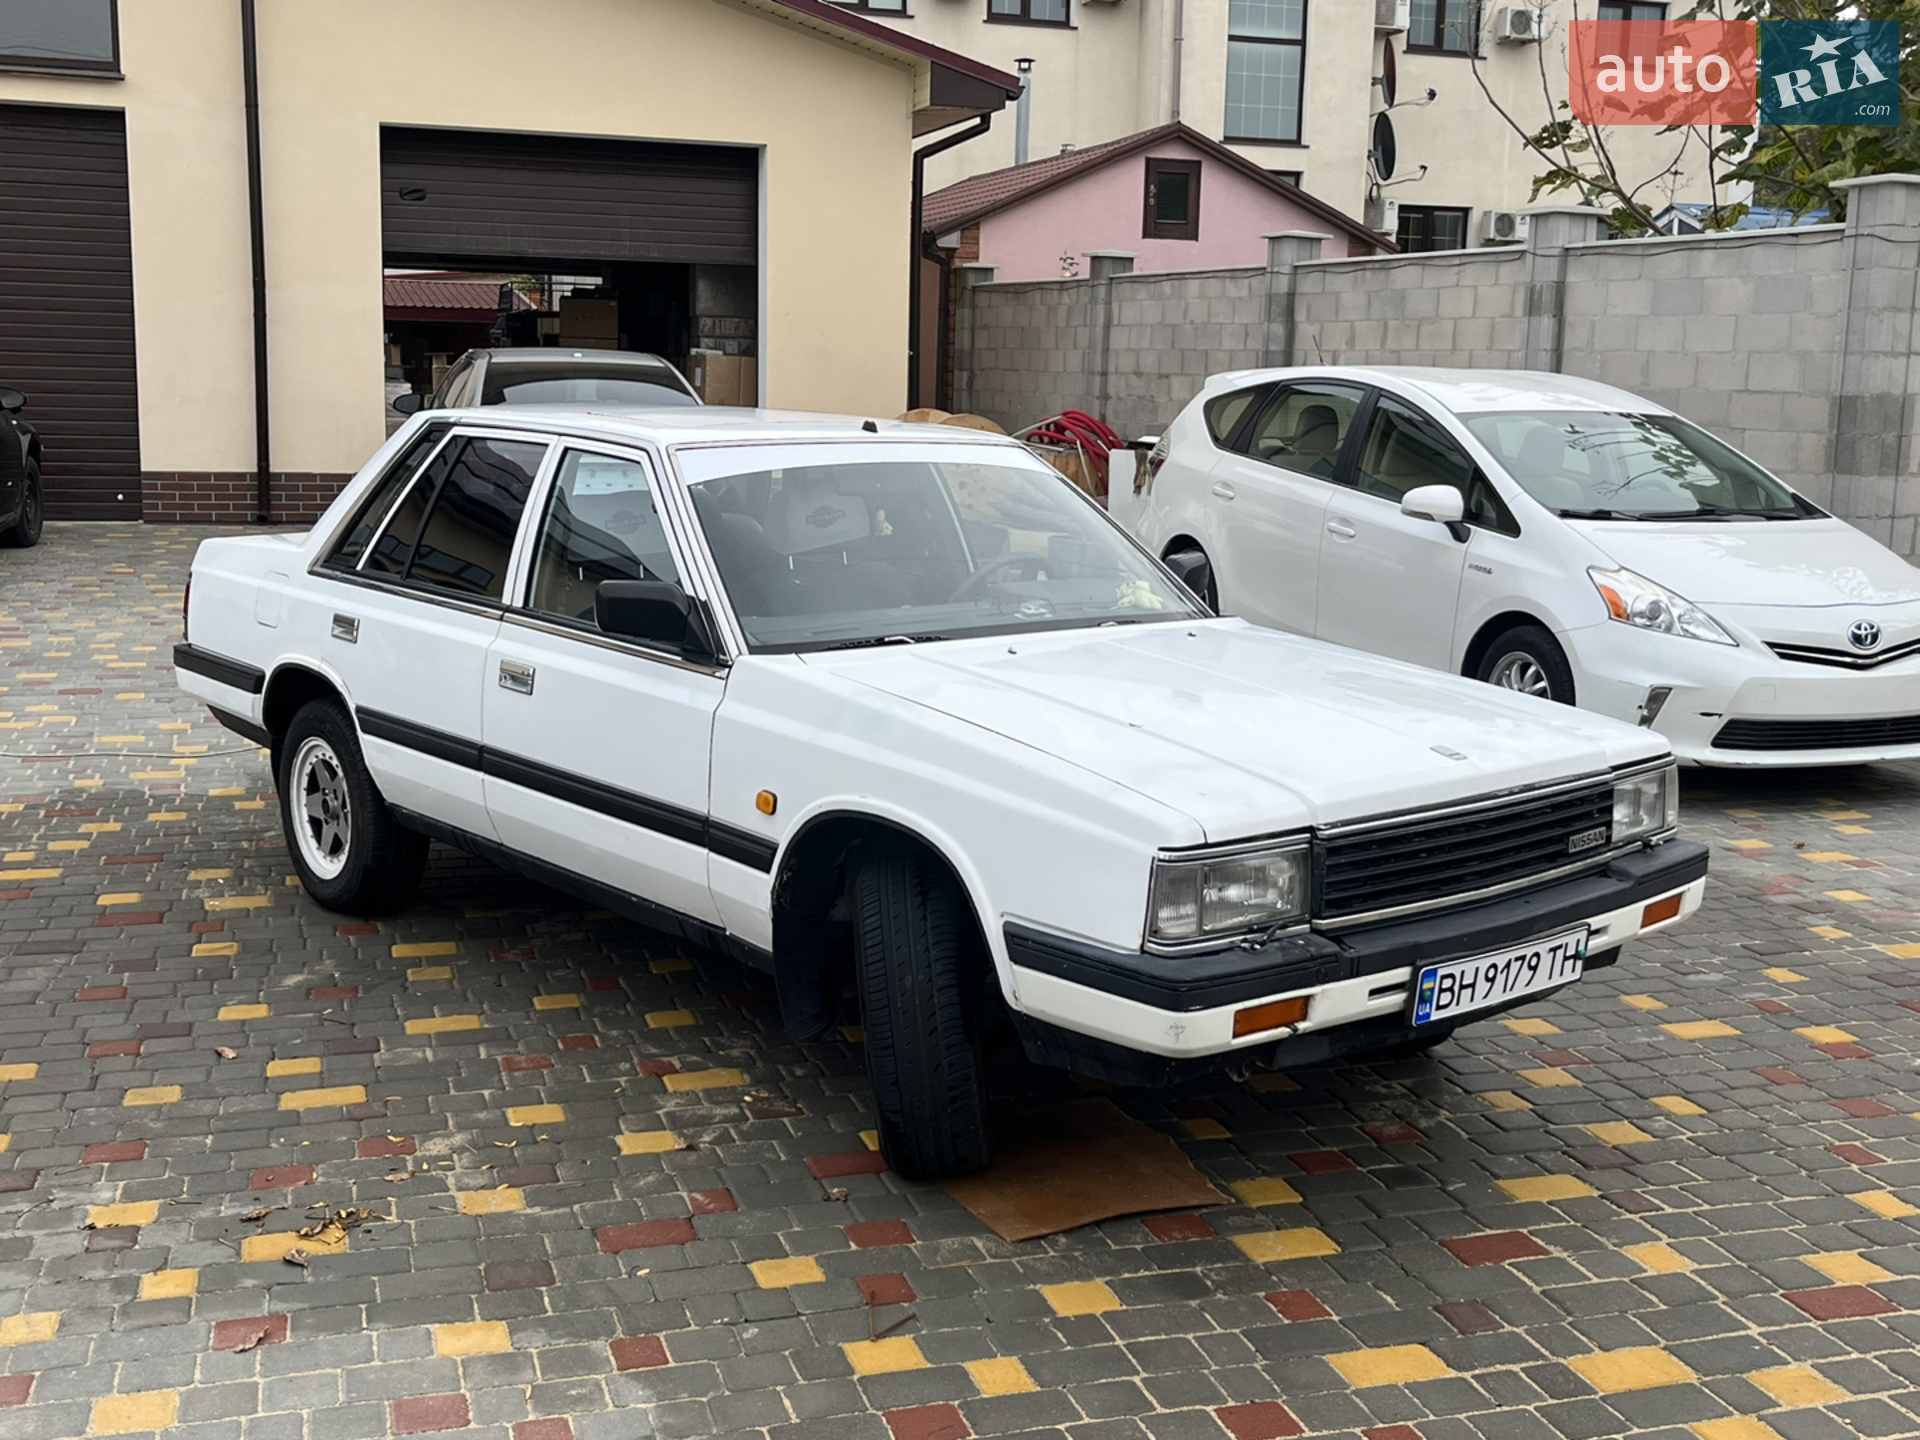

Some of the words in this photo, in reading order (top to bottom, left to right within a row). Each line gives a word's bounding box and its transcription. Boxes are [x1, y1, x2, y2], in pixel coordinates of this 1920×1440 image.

[1570, 829, 1605, 850] NISSAN
[1434, 966, 1480, 1012] BH
[1482, 951, 1541, 1000] 9179
[1548, 938, 1581, 981] TH
[1418, 1002, 1431, 1016] UA
